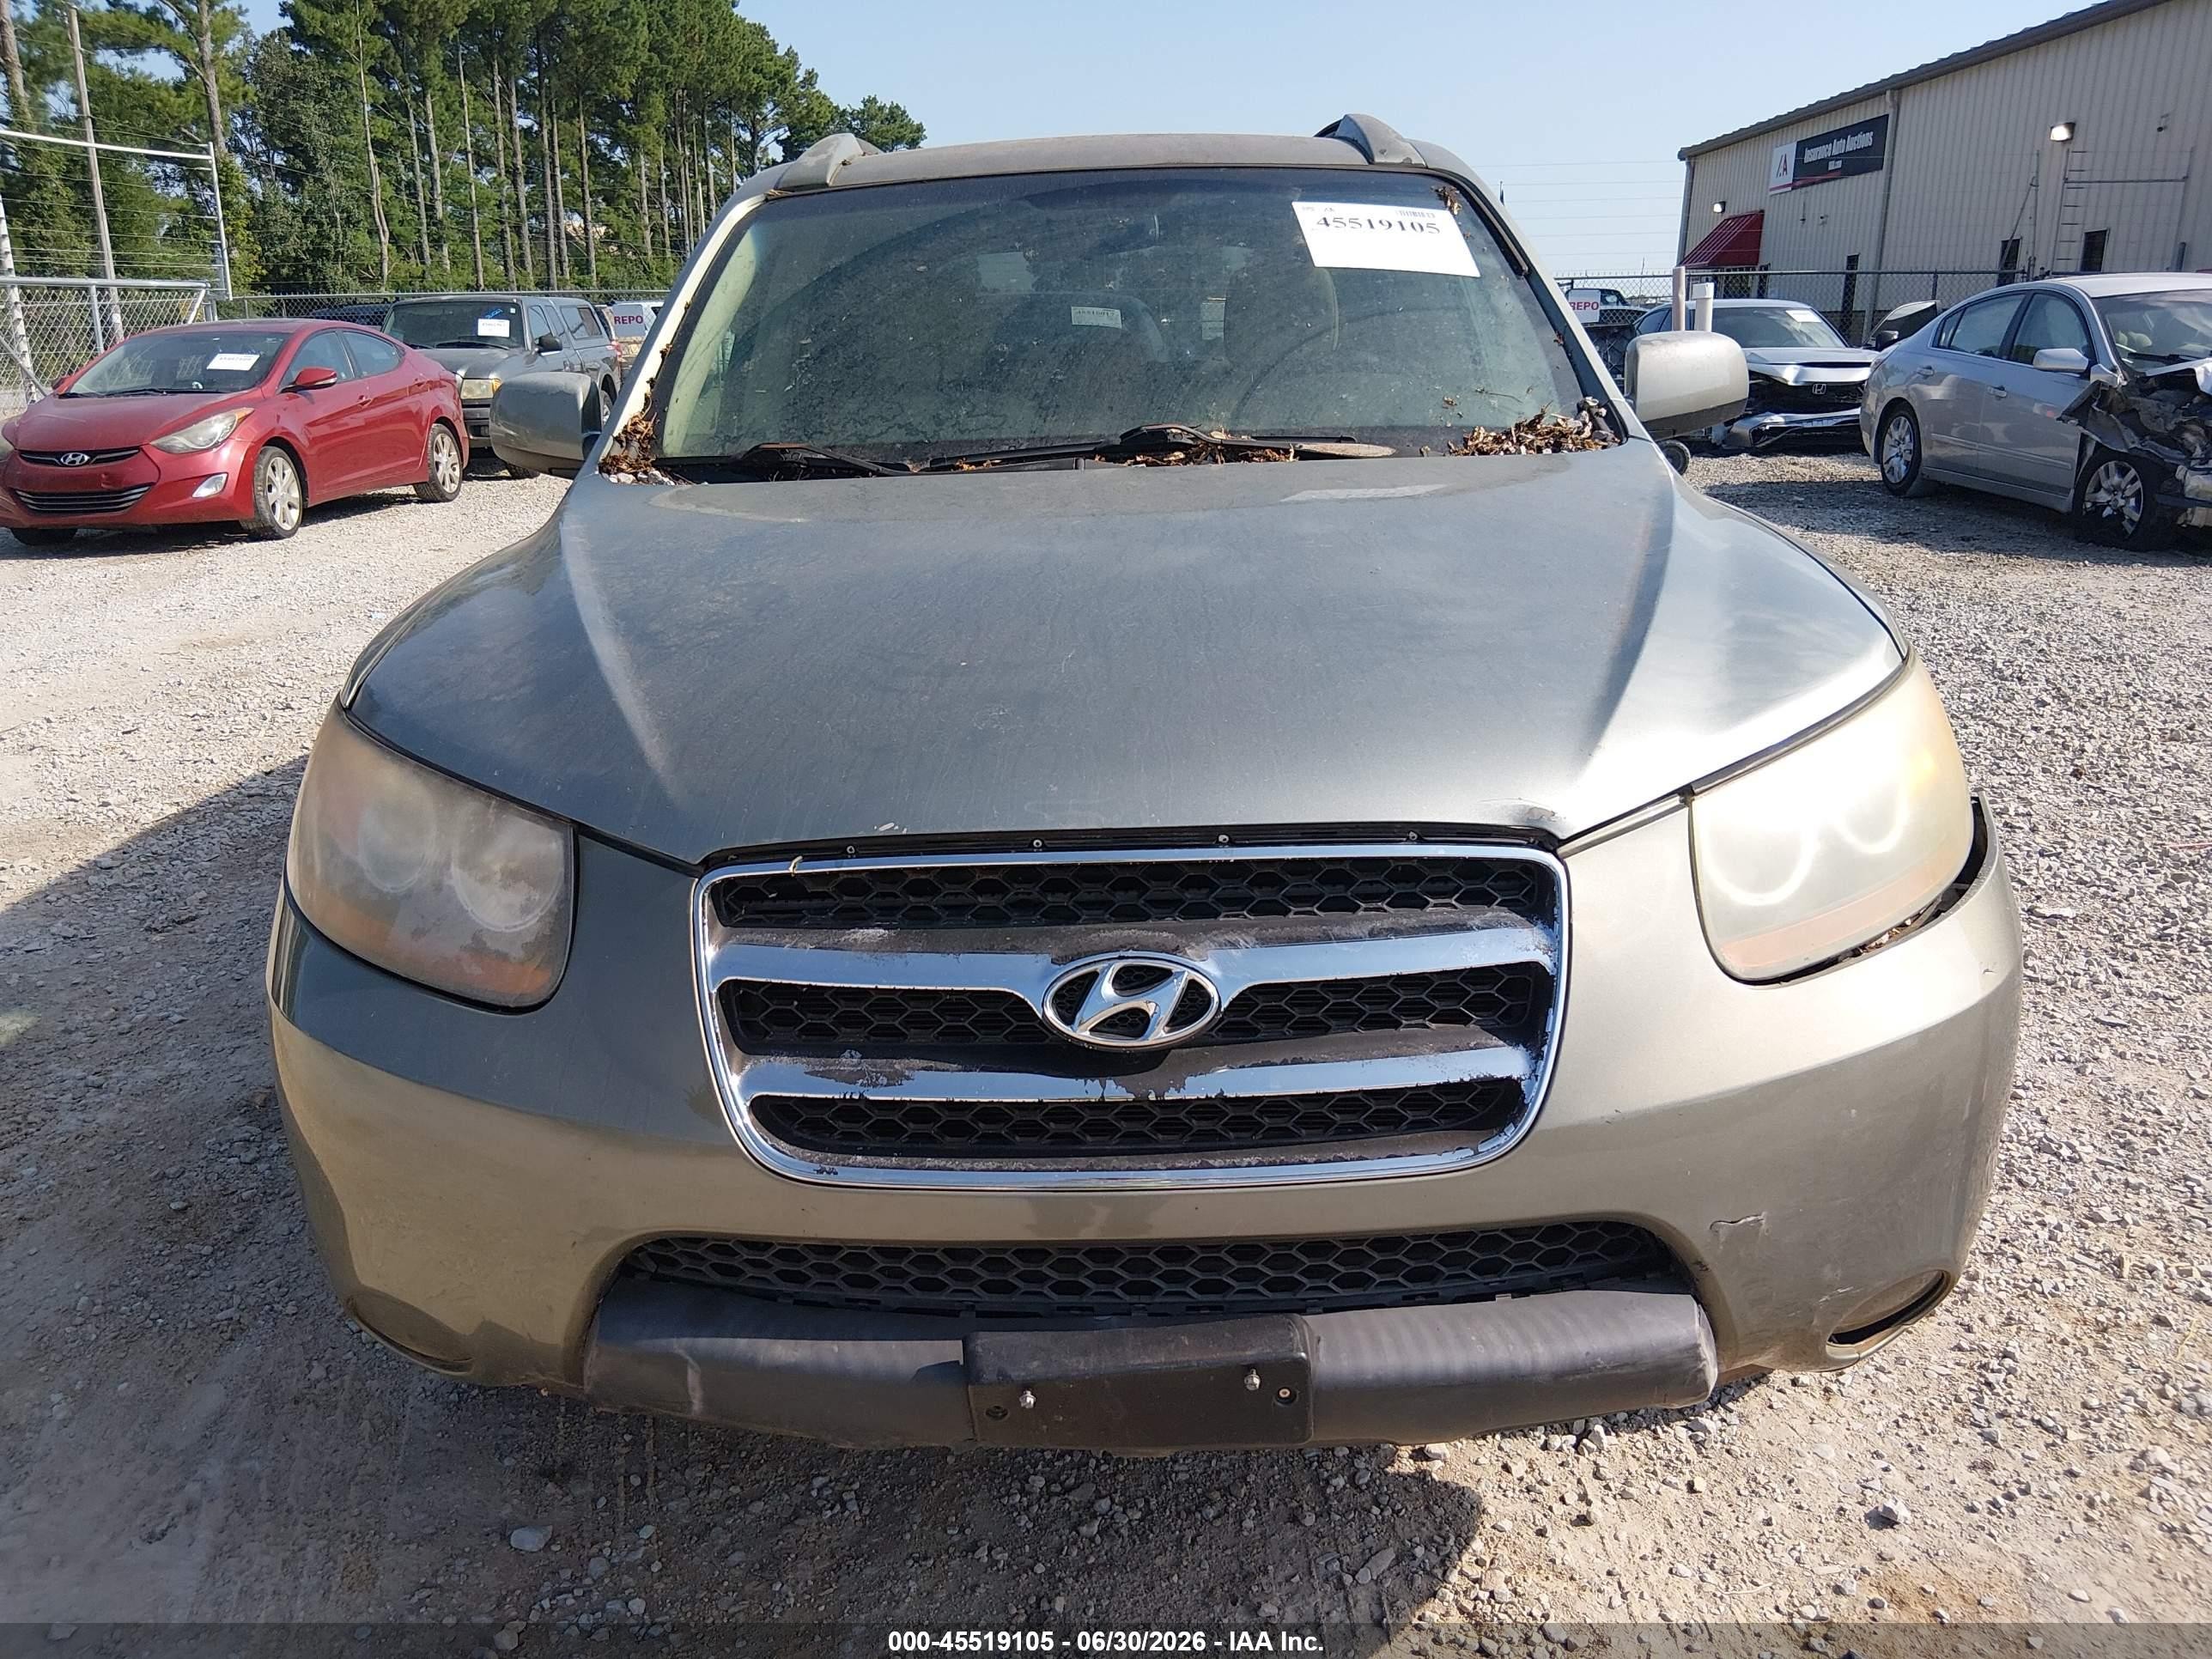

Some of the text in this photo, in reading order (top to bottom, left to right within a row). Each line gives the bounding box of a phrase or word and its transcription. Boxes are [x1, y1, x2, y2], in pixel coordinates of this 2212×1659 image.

[1804, 132, 1873, 163] Insurance Auto Auctions
[1316, 216, 1440, 234] 45519105
[614, 315, 643, 325] REPO
